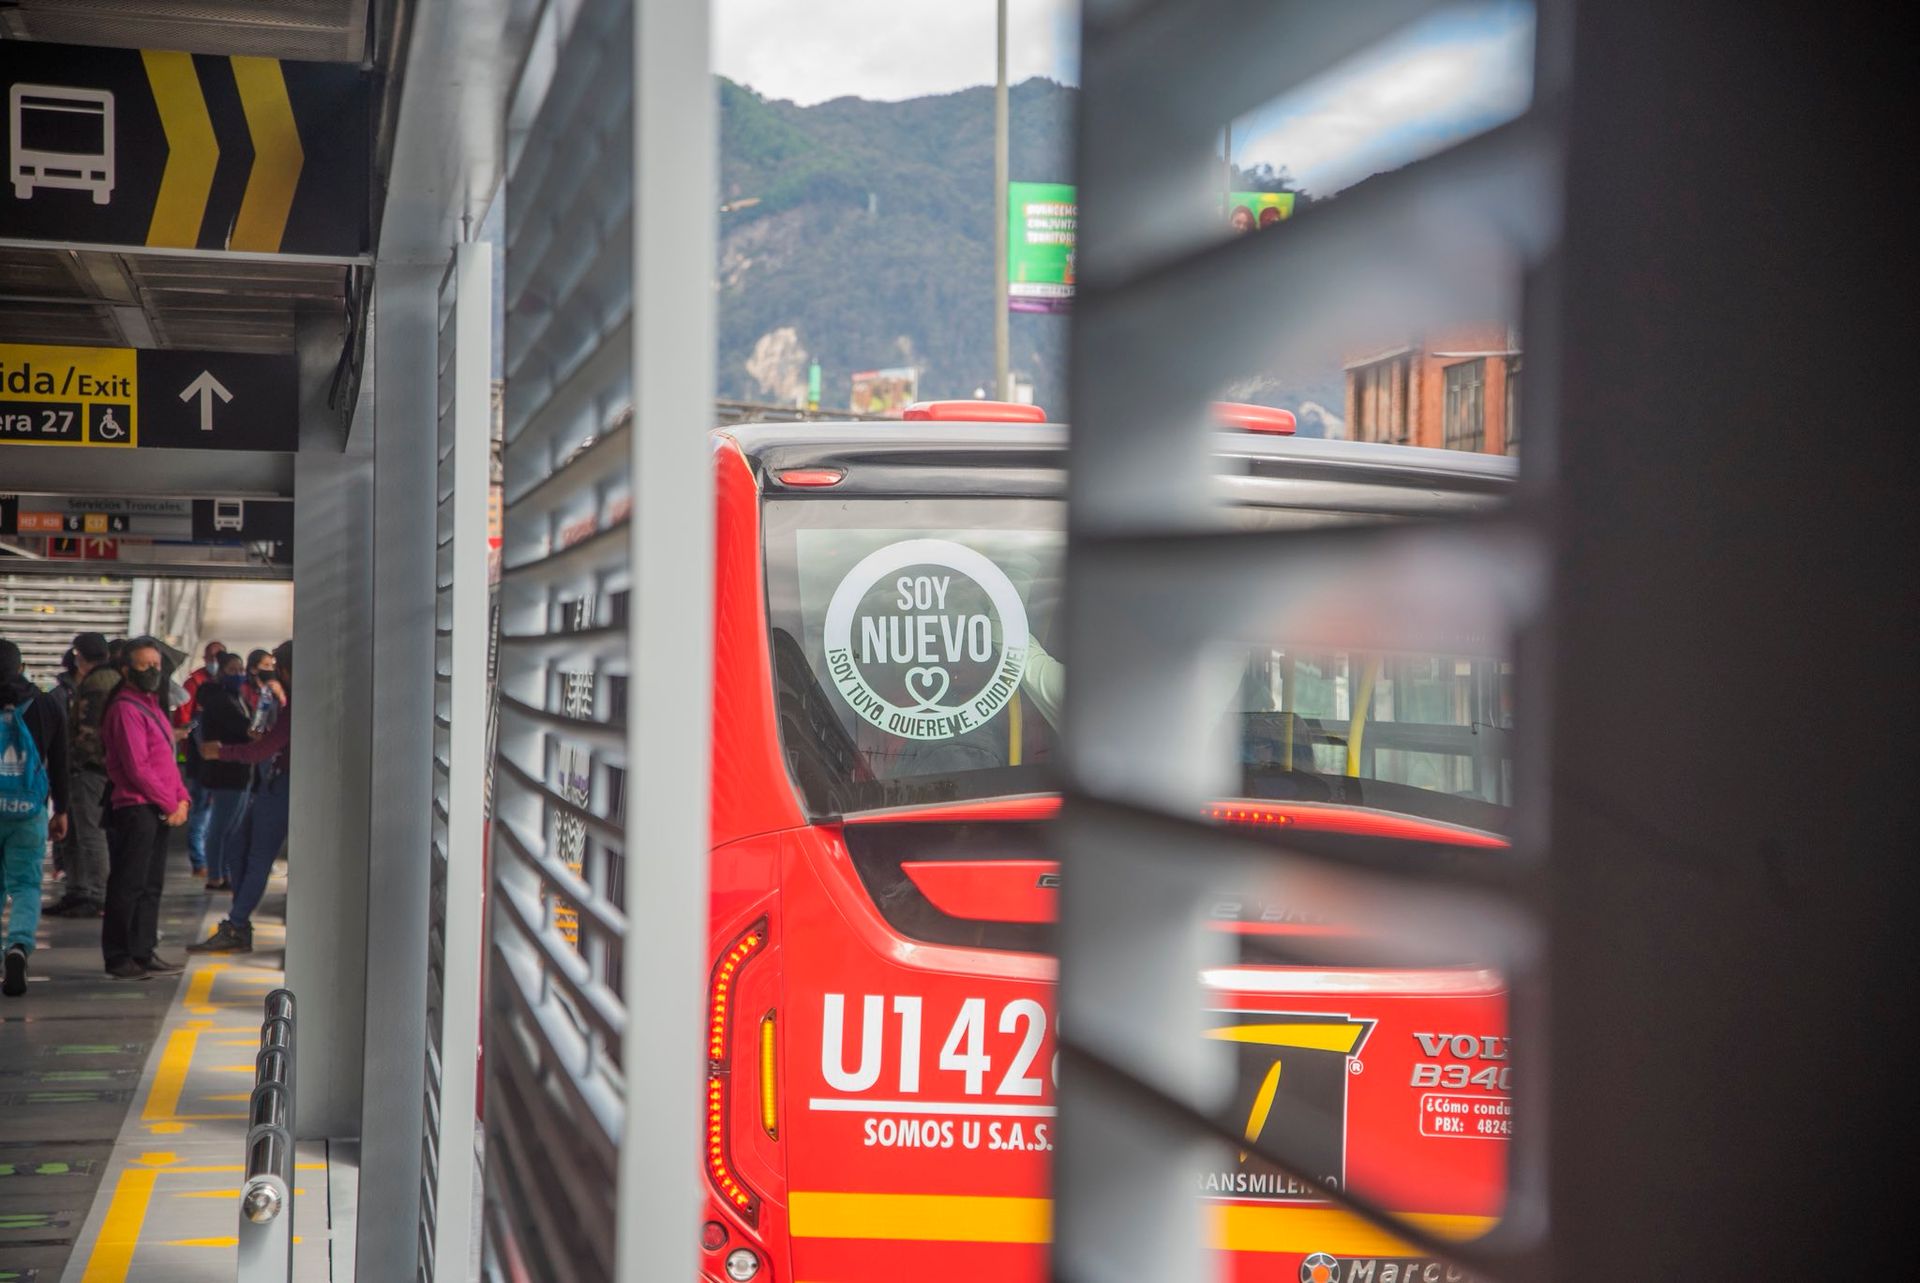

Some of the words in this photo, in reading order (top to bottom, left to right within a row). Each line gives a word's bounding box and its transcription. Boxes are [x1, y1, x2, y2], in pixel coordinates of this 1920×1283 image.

[0, 414, 32, 432] ra
[41, 410, 74, 433] 27
[896, 576, 950, 610] SOY
[861, 614, 992, 664] NUEVO
[847, 681, 885, 726] TUYO,
[821, 993, 1059, 1096] U142
[1412, 1032, 1513, 1060] VOL
[1426, 1098, 1470, 1113] ¿Cómo
[863, 1117, 954, 1148] SOMOS
[962, 1121, 981, 1149] U
[988, 1122, 1053, 1151] S.A.S.
[1434, 1117, 1464, 1133] PBX:
